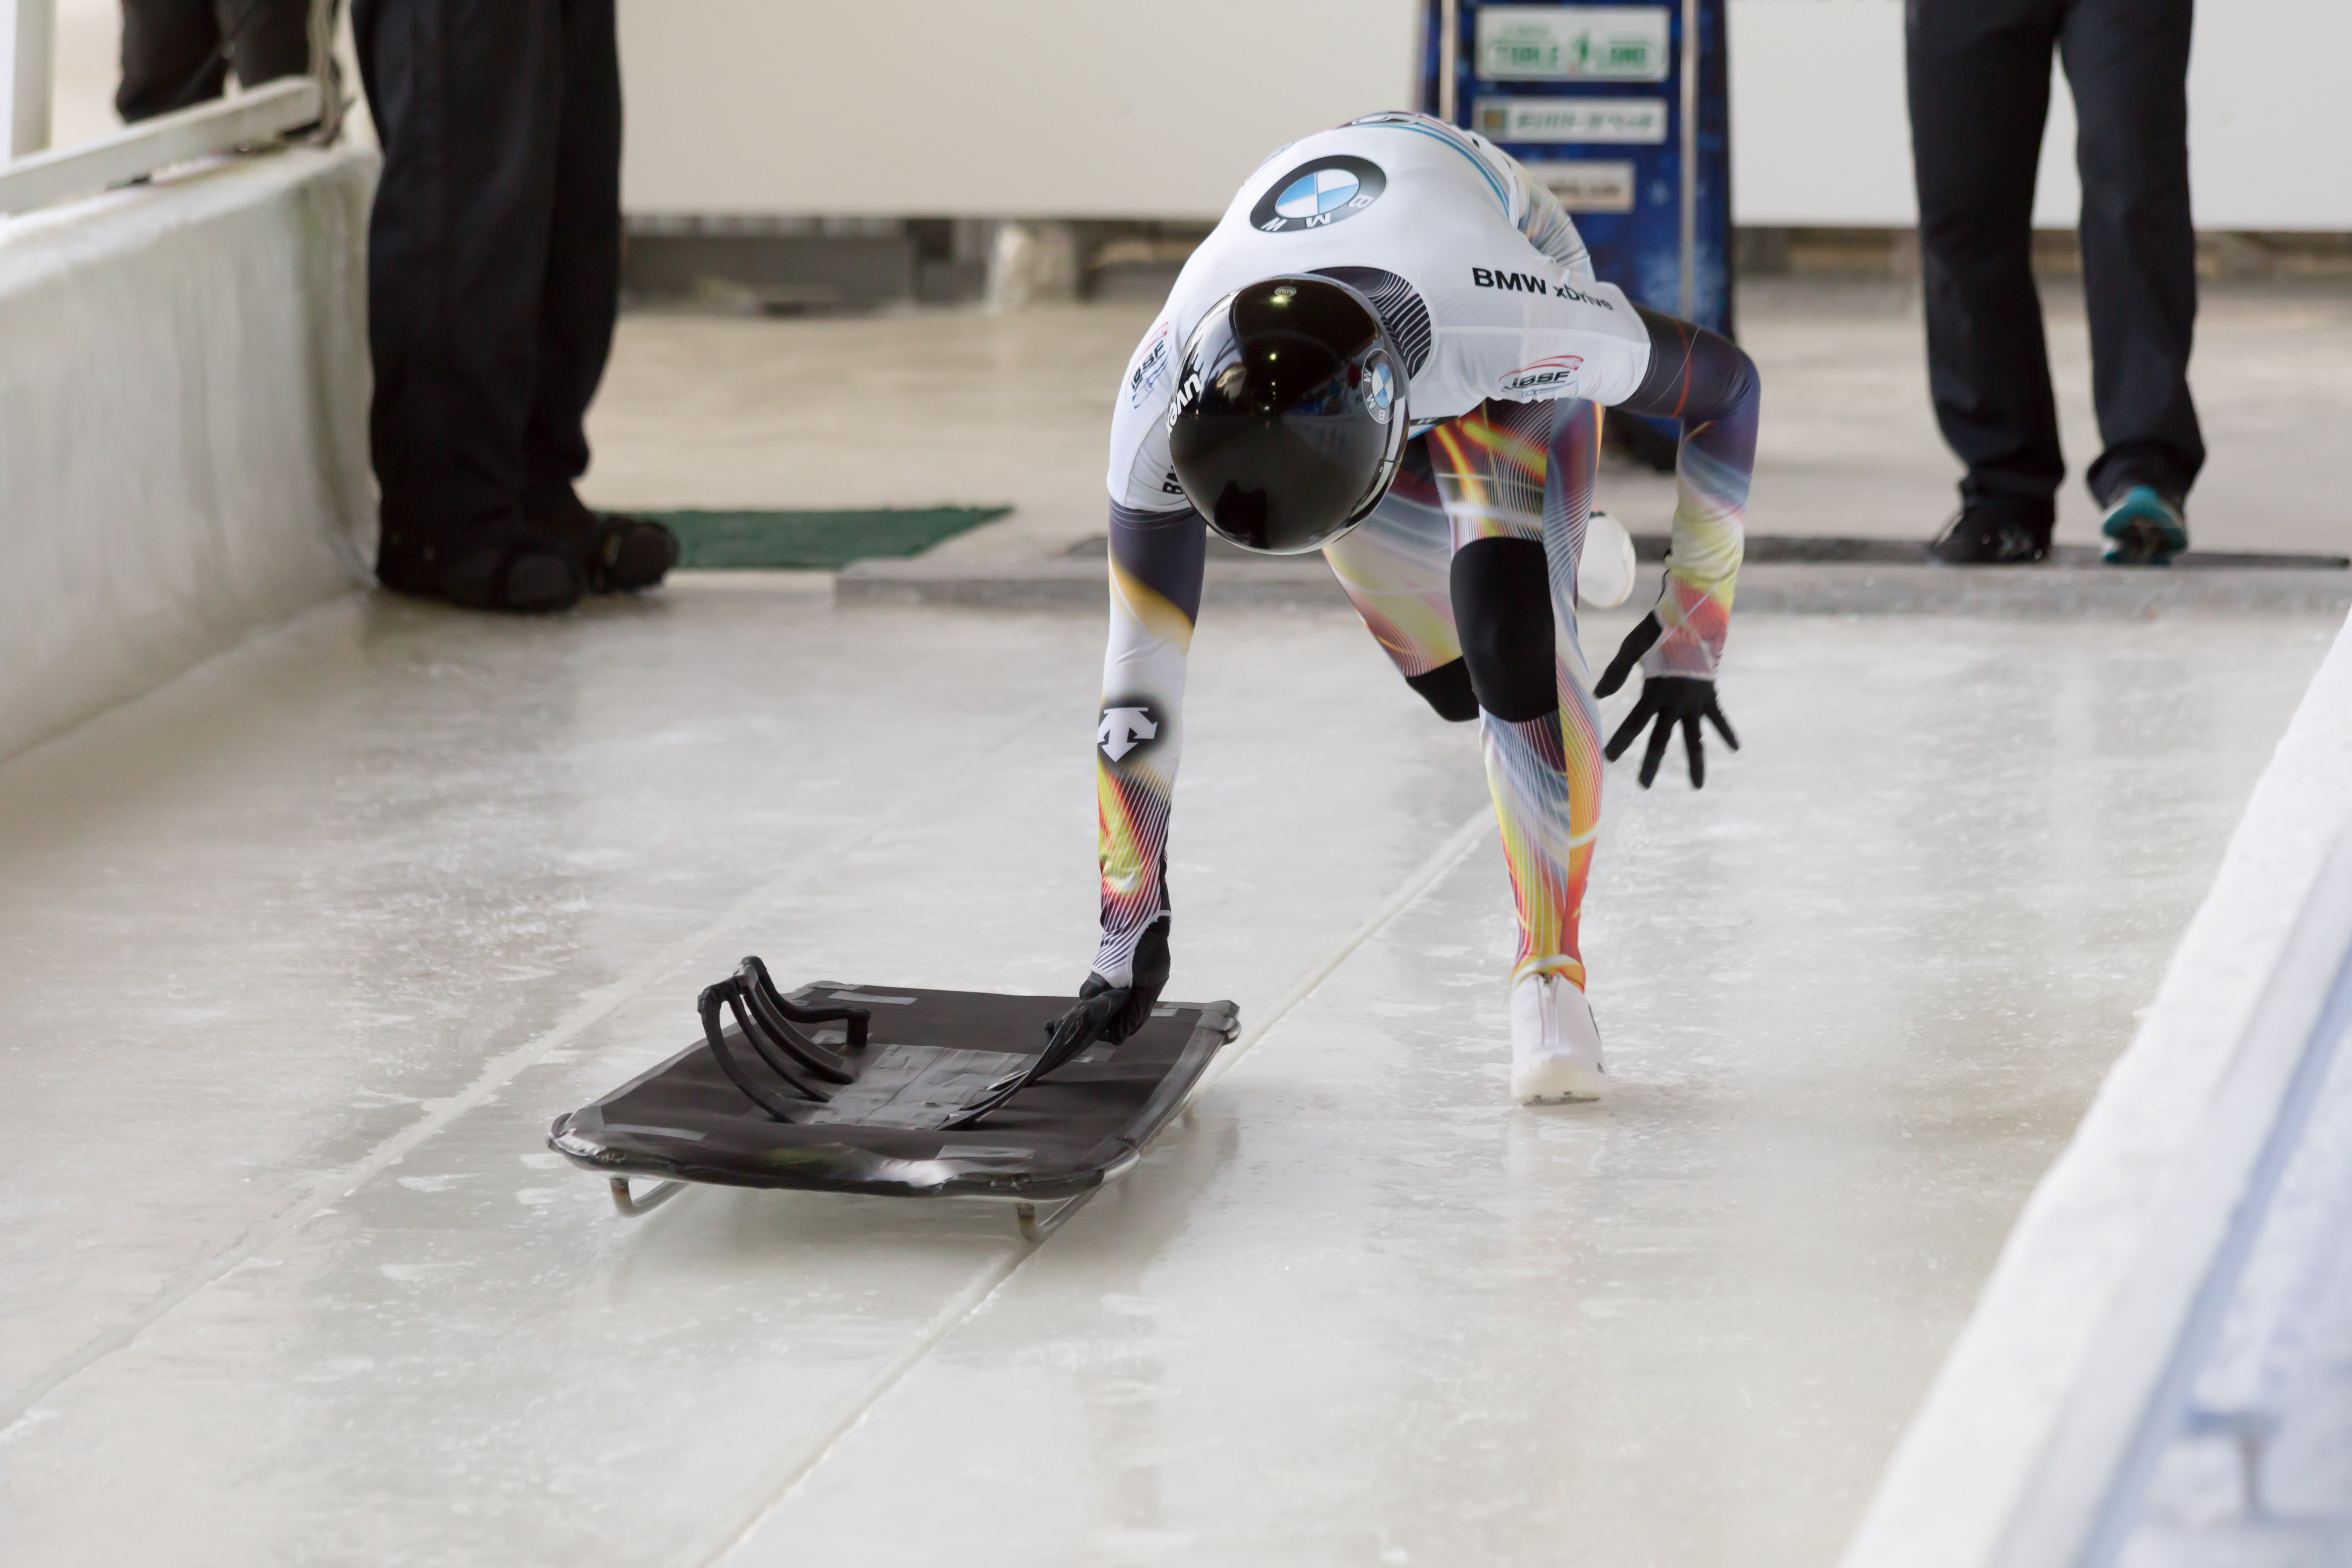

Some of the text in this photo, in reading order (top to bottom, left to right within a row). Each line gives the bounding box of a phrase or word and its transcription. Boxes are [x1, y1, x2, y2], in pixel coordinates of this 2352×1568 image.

[1261, 195, 1374, 232] BMW
[1472, 267, 1614, 310] BMW xDrive
[1363, 368, 1385, 421] BMW
[1512, 371, 1570, 387] IBSF
